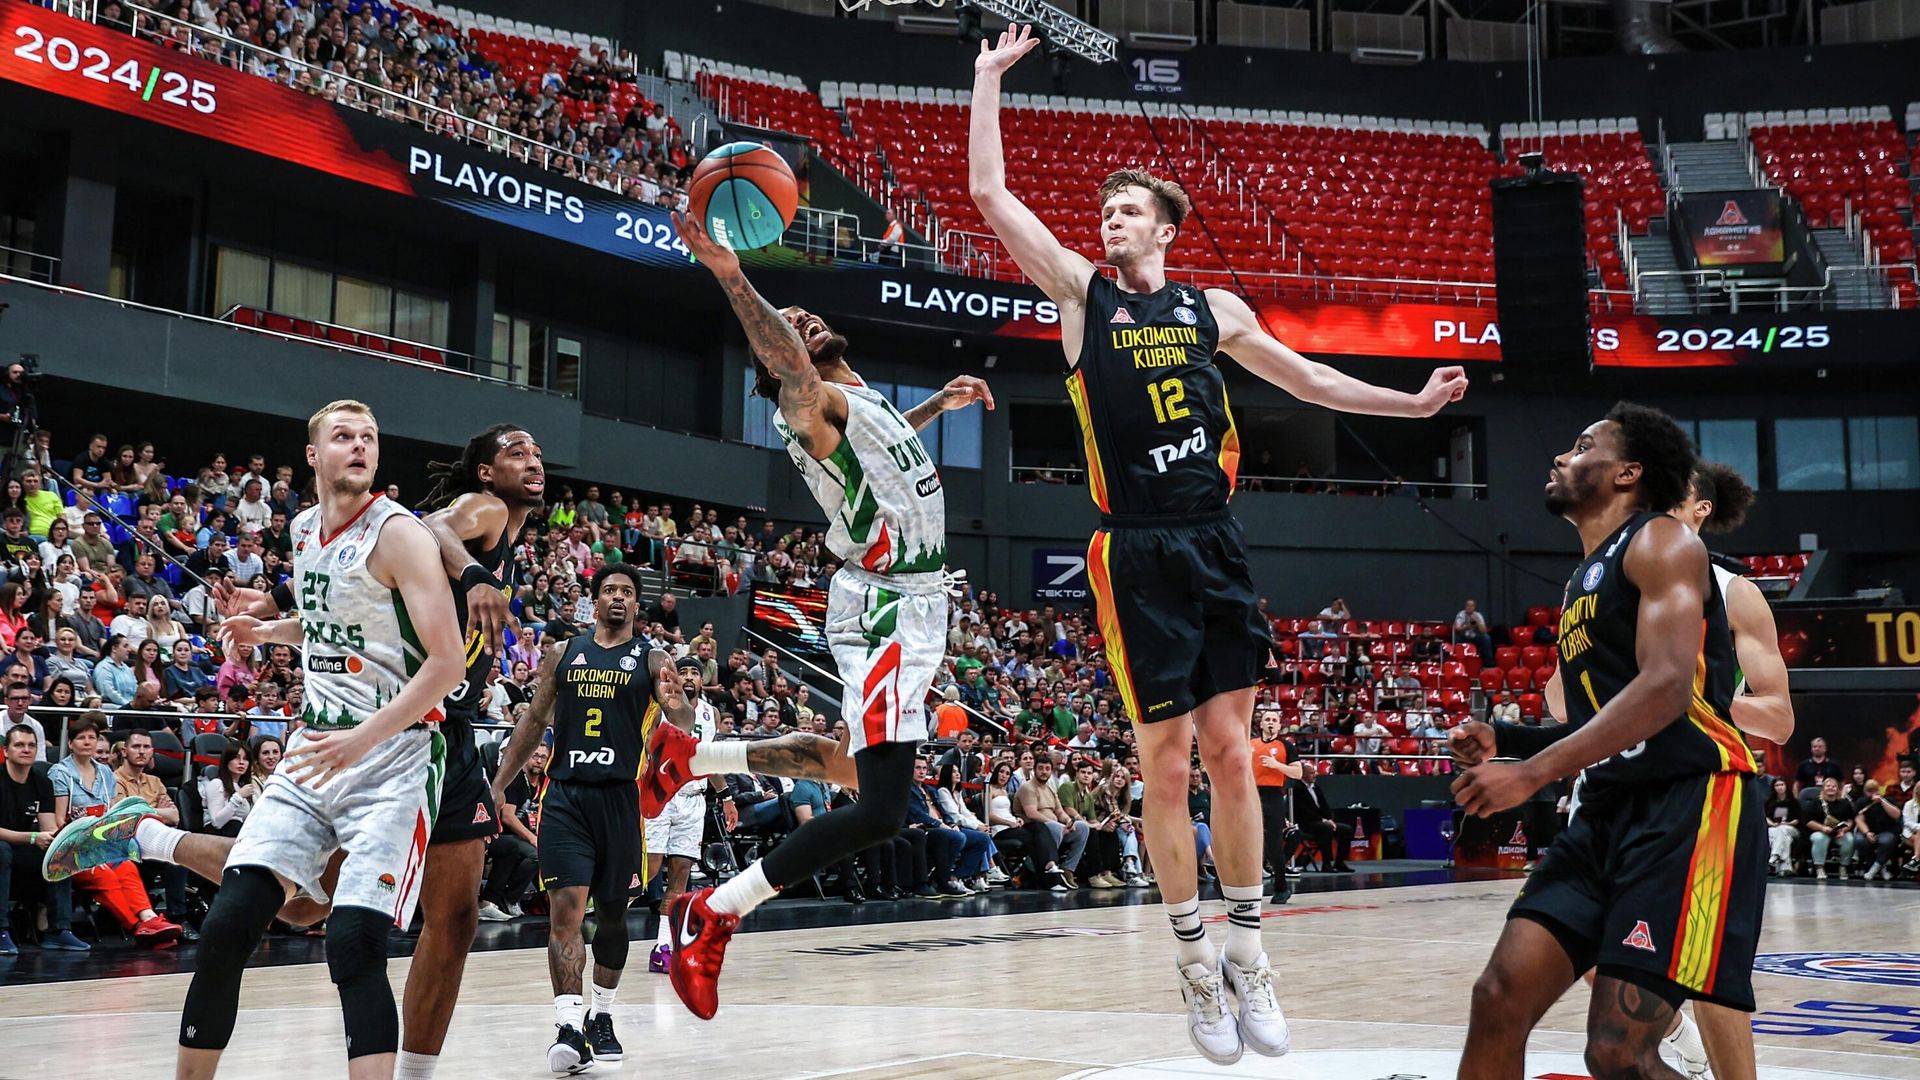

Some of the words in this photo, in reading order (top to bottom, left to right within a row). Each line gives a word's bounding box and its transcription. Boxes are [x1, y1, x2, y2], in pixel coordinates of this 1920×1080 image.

[14, 25, 217, 114] 2024/25
[1132, 58, 1180, 83] 16
[409, 145, 585, 224] PLAYOFFS
[615, 212, 698, 263] 2024
[881, 280, 1060, 324] PLAYOFFS
[1112, 326, 1198, 350] LOKOMOTIV
[1657, 325, 1830, 353] 2024/25
[1133, 346, 1189, 369] KUBAN
[1147, 377, 1191, 424] 12
[1046, 555, 1085, 585] 7
[302, 570, 330, 612] 27
[567, 668, 632, 686] LOKOMOTIV
[577, 683, 616, 700] KUBAN
[584, 707, 603, 738] 2
